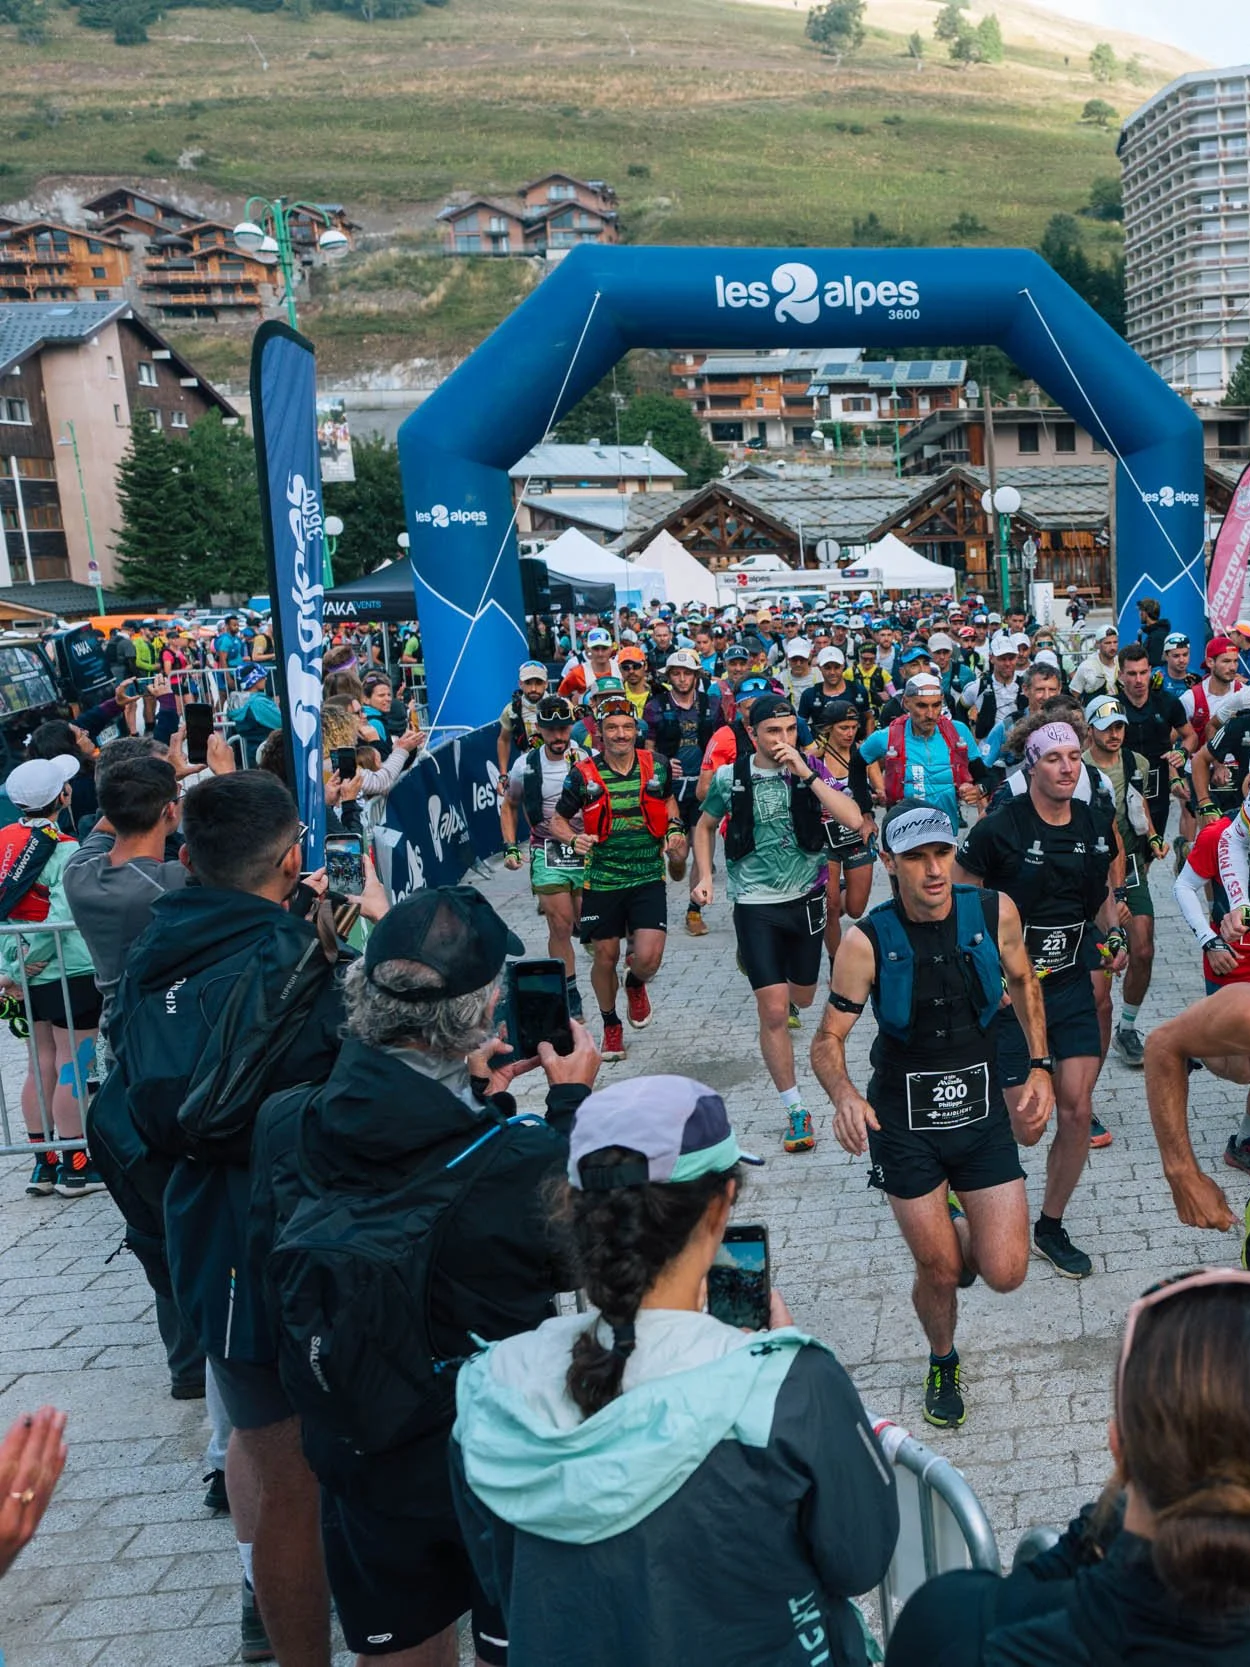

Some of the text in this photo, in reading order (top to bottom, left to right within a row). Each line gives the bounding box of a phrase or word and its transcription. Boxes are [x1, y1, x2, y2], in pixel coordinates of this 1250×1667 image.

[715, 262, 920, 324] les 2 alpes
[888, 309, 920, 320] 3600
[1175, 491, 1199, 505] alpes
[303, 489, 323, 541] 3600
[415, 510, 431, 522] les
[450, 509, 487, 524] alpes
[322, 601, 357, 616] YAKA
[473, 782, 495, 813] les
[13, 837, 39, 881] SALOMON
[1042, 938, 1067, 951] 221
[280, 974, 298, 1001] KIPRUN
[932, 1083, 968, 1102] 200
[939, 1101, 963, 1109] Philippe
[787, 1589, 829, 1667] IGHT
